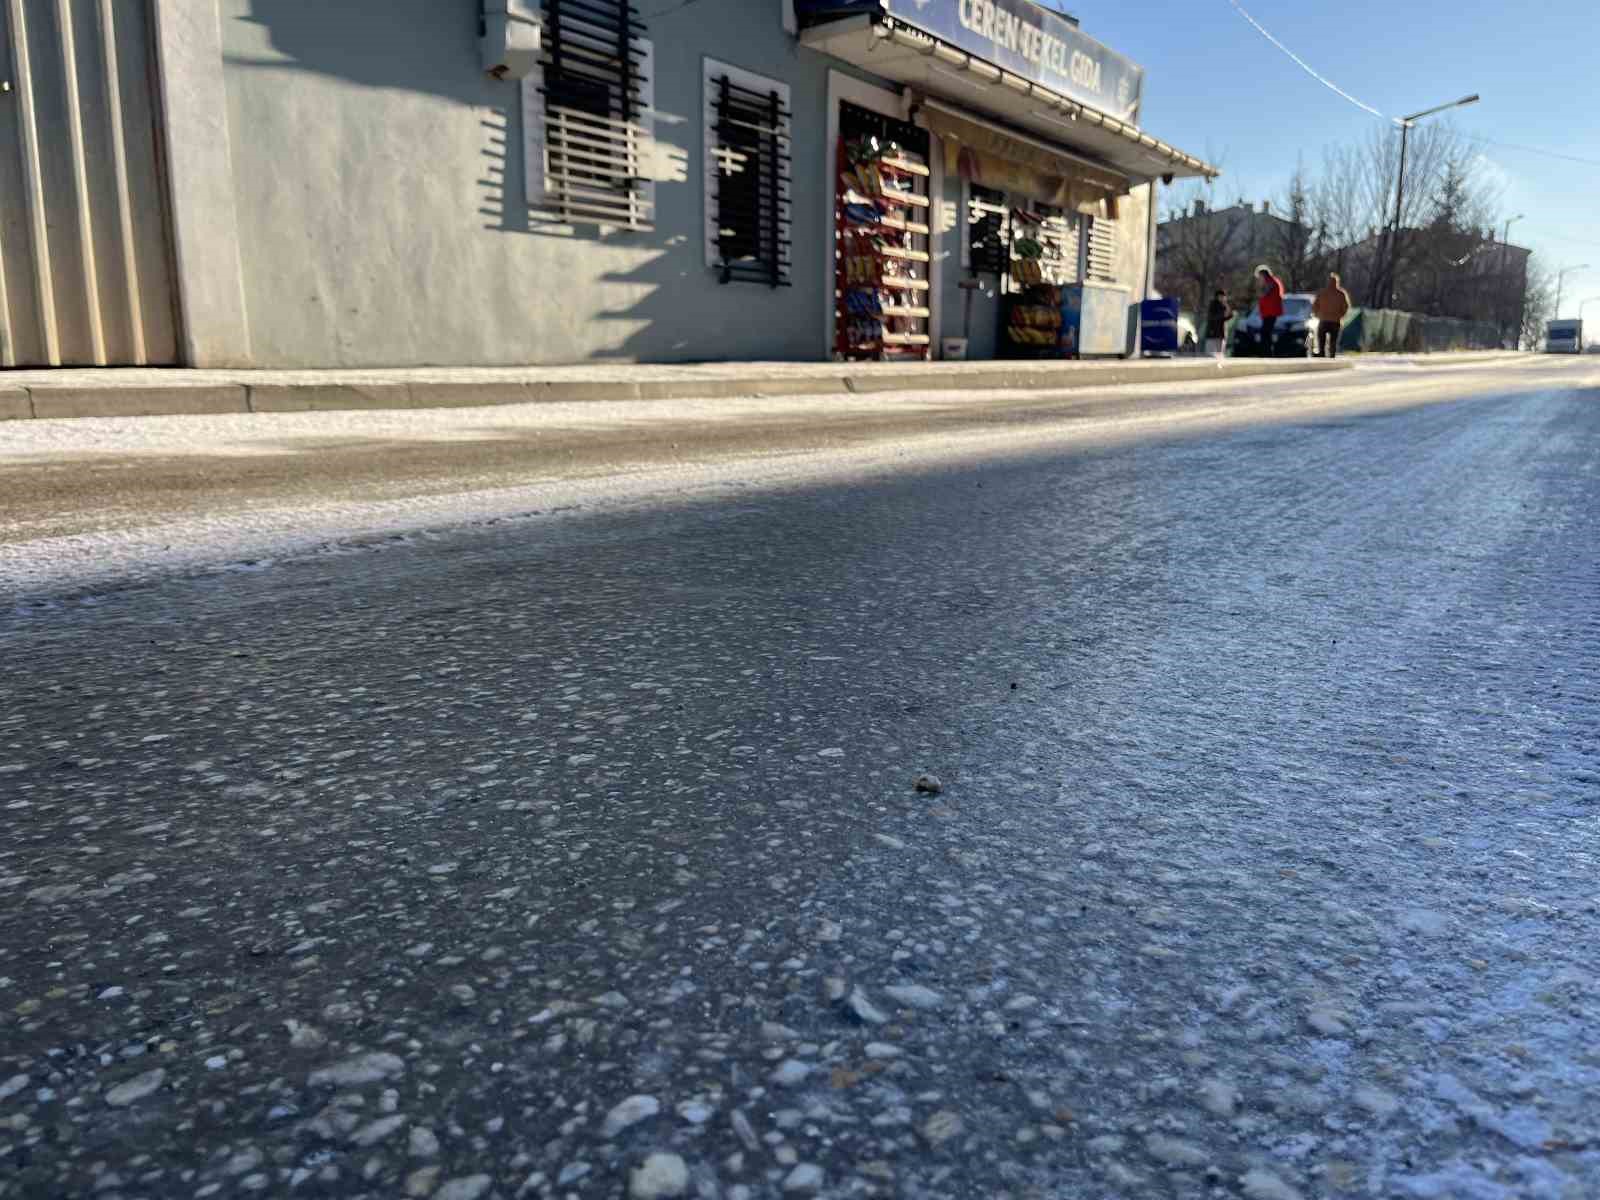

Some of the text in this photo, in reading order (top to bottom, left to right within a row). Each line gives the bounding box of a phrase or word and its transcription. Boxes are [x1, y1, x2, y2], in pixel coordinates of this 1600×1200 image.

[959, 0, 1102, 95] CEREN TEKEL GIDA
